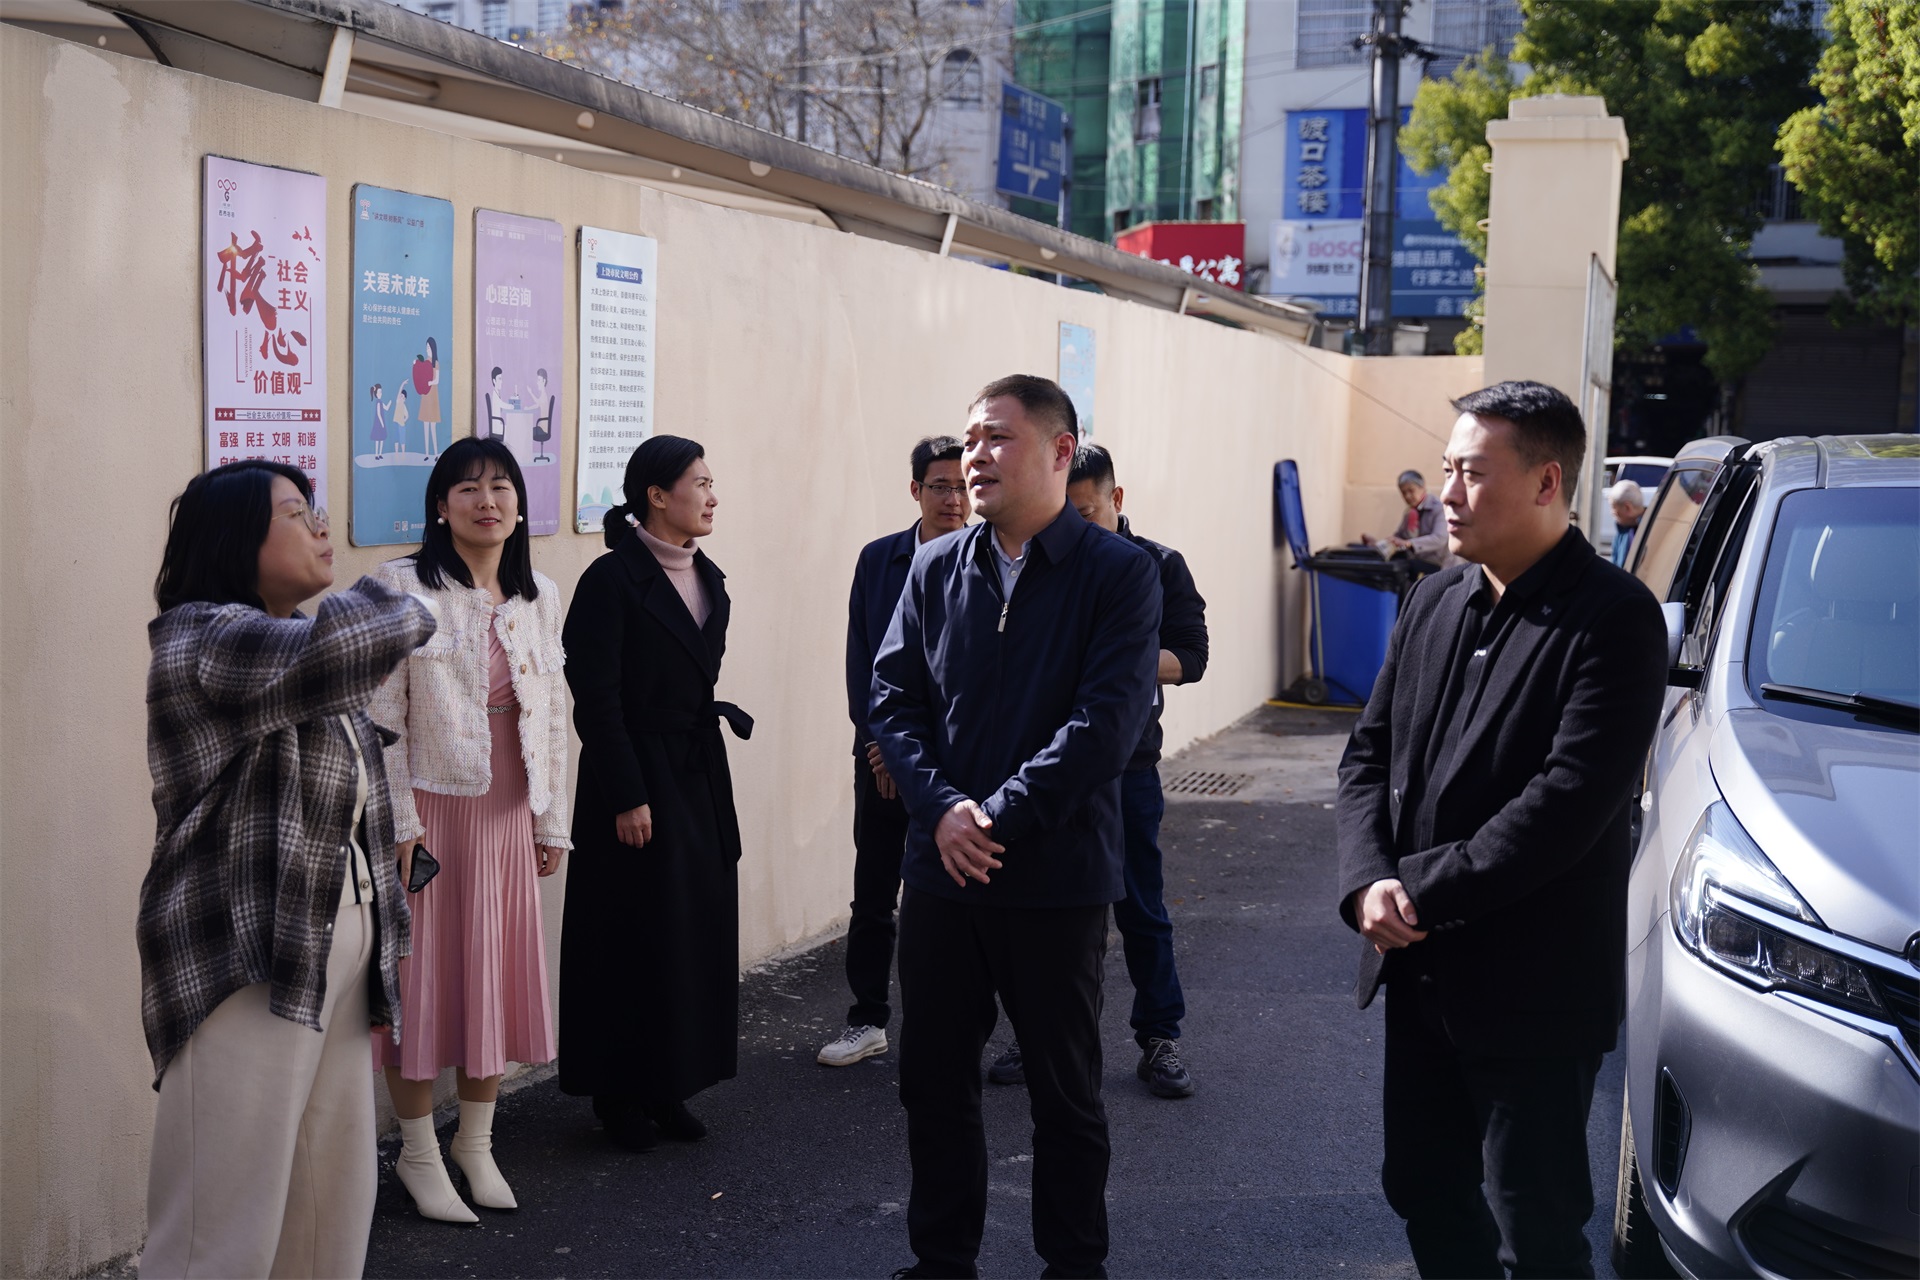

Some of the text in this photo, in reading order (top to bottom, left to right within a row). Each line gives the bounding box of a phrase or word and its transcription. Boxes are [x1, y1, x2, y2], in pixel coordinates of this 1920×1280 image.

[1297, 116, 1329, 214] 渡口茶楼
[1308, 241, 1363, 258] BOSC
[217, 230, 277, 331] 核
[277, 259, 308, 284] 社会
[363, 270, 430, 298] 关爱未成年
[485, 284, 532, 308] 心理咨询
[277, 288, 308, 312] 主义
[362, 303, 420, 316] 关心保护未成年人健康成长
[362, 314, 402, 326] 是社会共同的责任
[259, 327, 307, 366] 心
[253, 370, 302, 395] 价值观
[246, 410, 291, 420] 社会主义核心价值观
[219, 432, 317, 448] 富强 民主 文明 和谐
[298, 455, 317, 471] 法治
